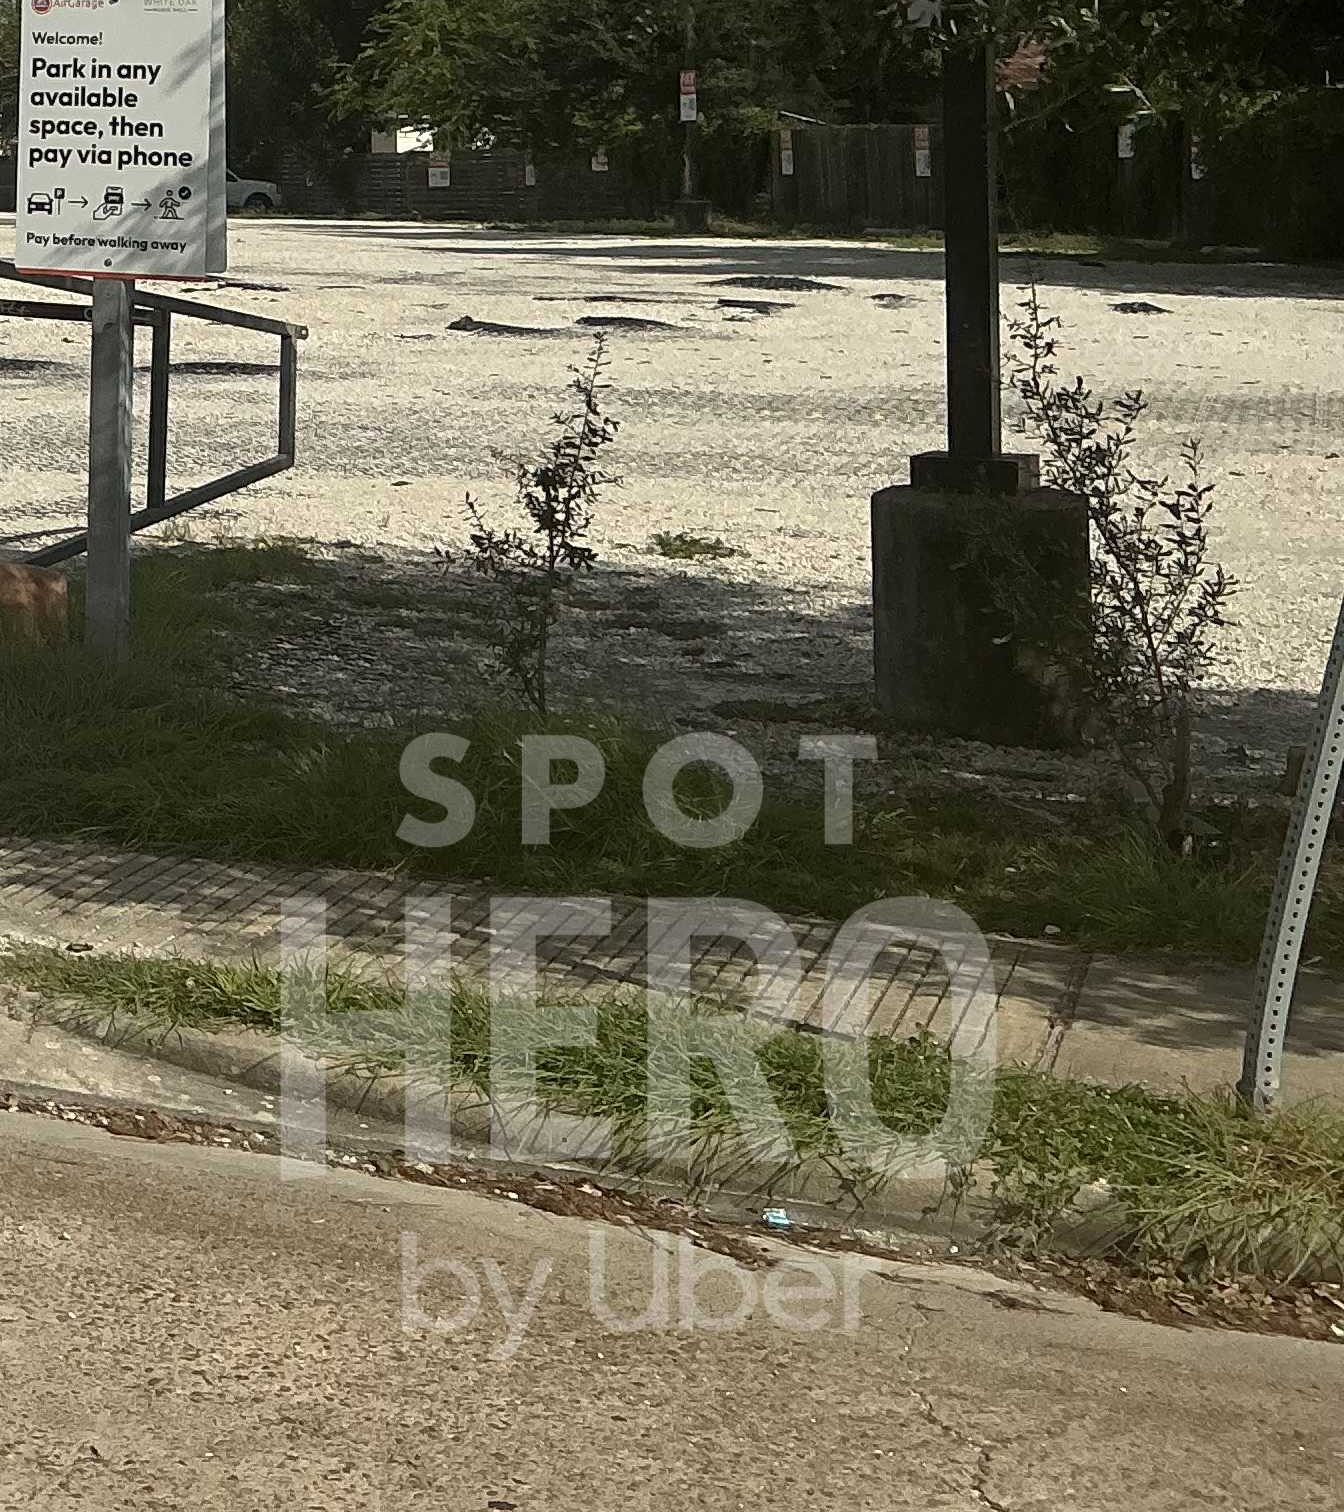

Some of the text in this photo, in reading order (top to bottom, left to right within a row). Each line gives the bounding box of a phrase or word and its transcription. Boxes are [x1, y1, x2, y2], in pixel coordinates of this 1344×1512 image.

[32, 31, 103, 45] Welcome!
[32, 57, 162, 85] Park in any
[30, 86, 138, 107] available
[29, 116, 164, 139] space, then
[29, 144, 193, 170] pay via phone
[26, 232, 187, 253] Pay before walking away
